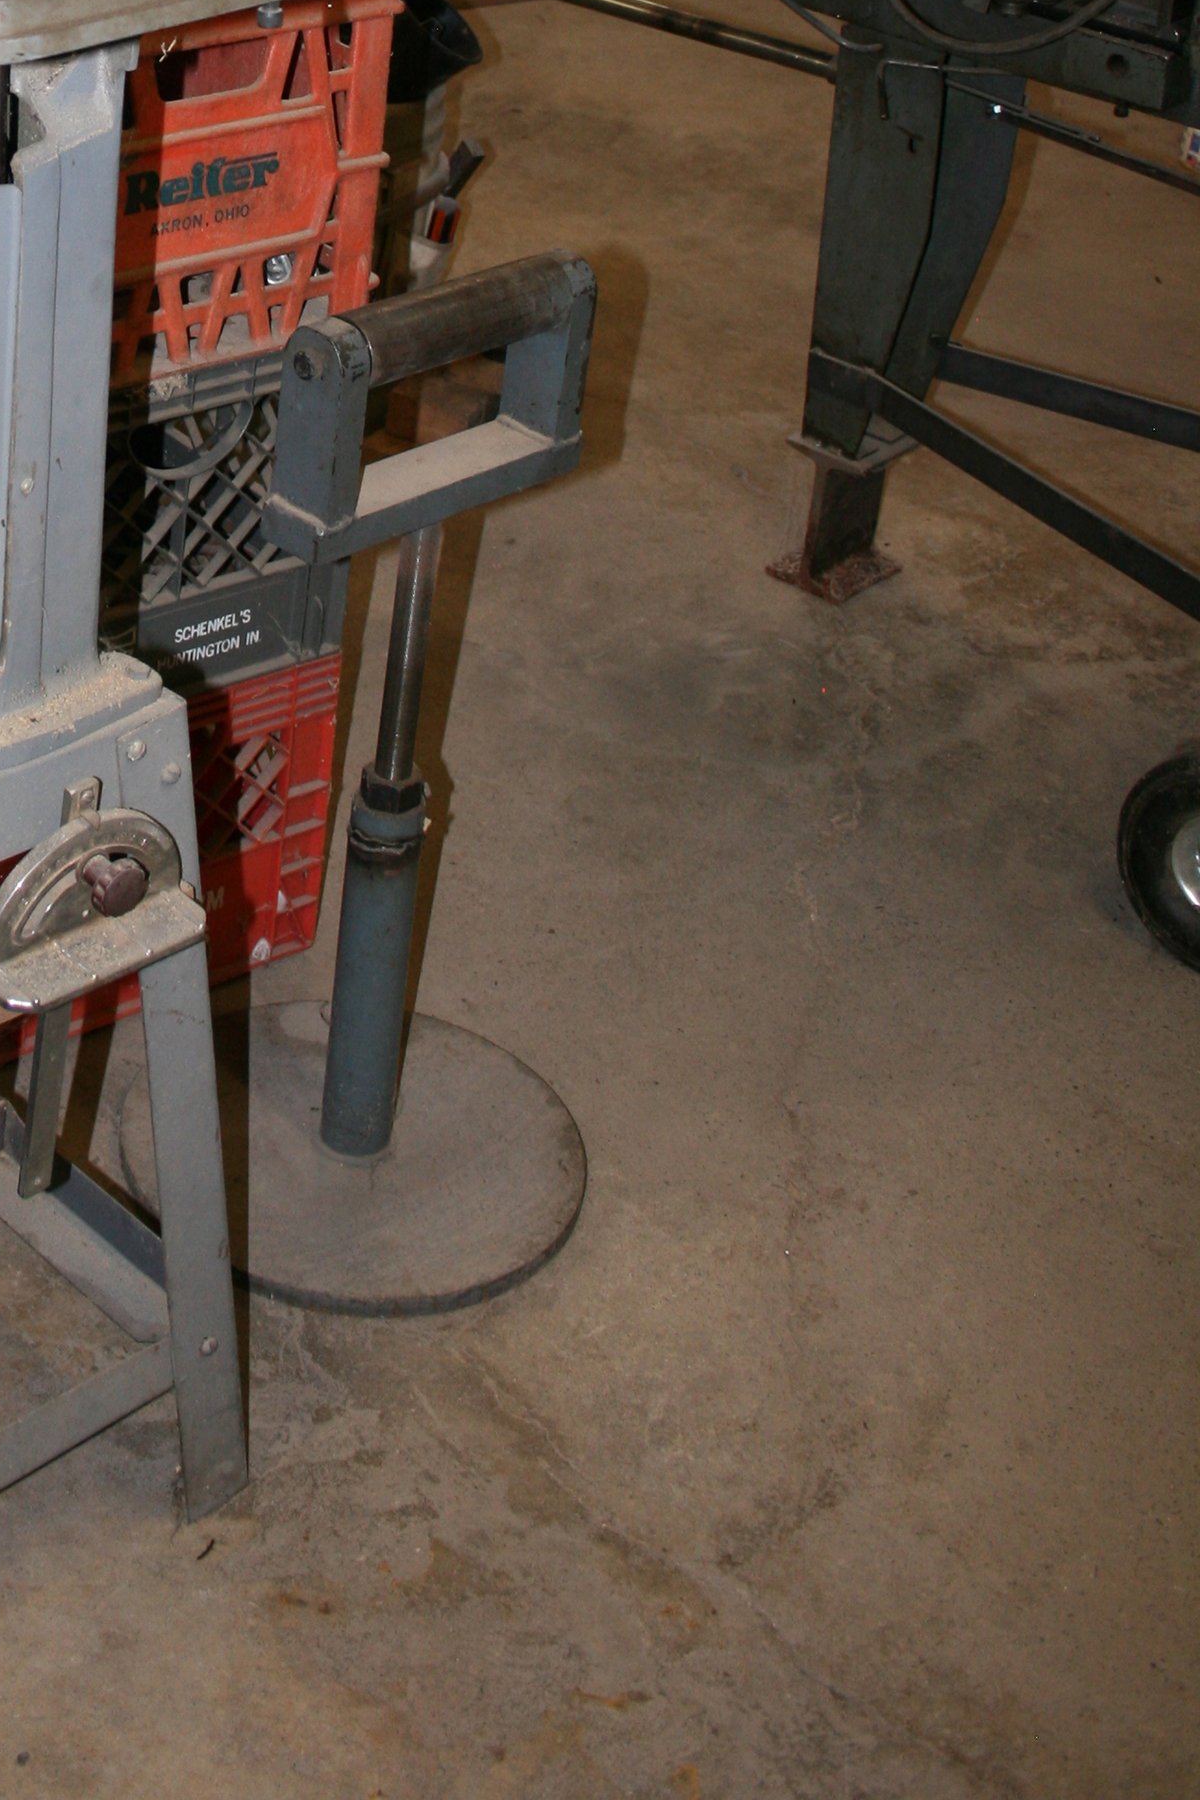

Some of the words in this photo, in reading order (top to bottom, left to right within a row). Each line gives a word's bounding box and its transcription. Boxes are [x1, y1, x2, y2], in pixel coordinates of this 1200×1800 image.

[214, 203, 251, 224] OHIO
[174, 608, 252, 644] SCHENKEL'S
[157, 635, 241, 672] HUNTINGTON
